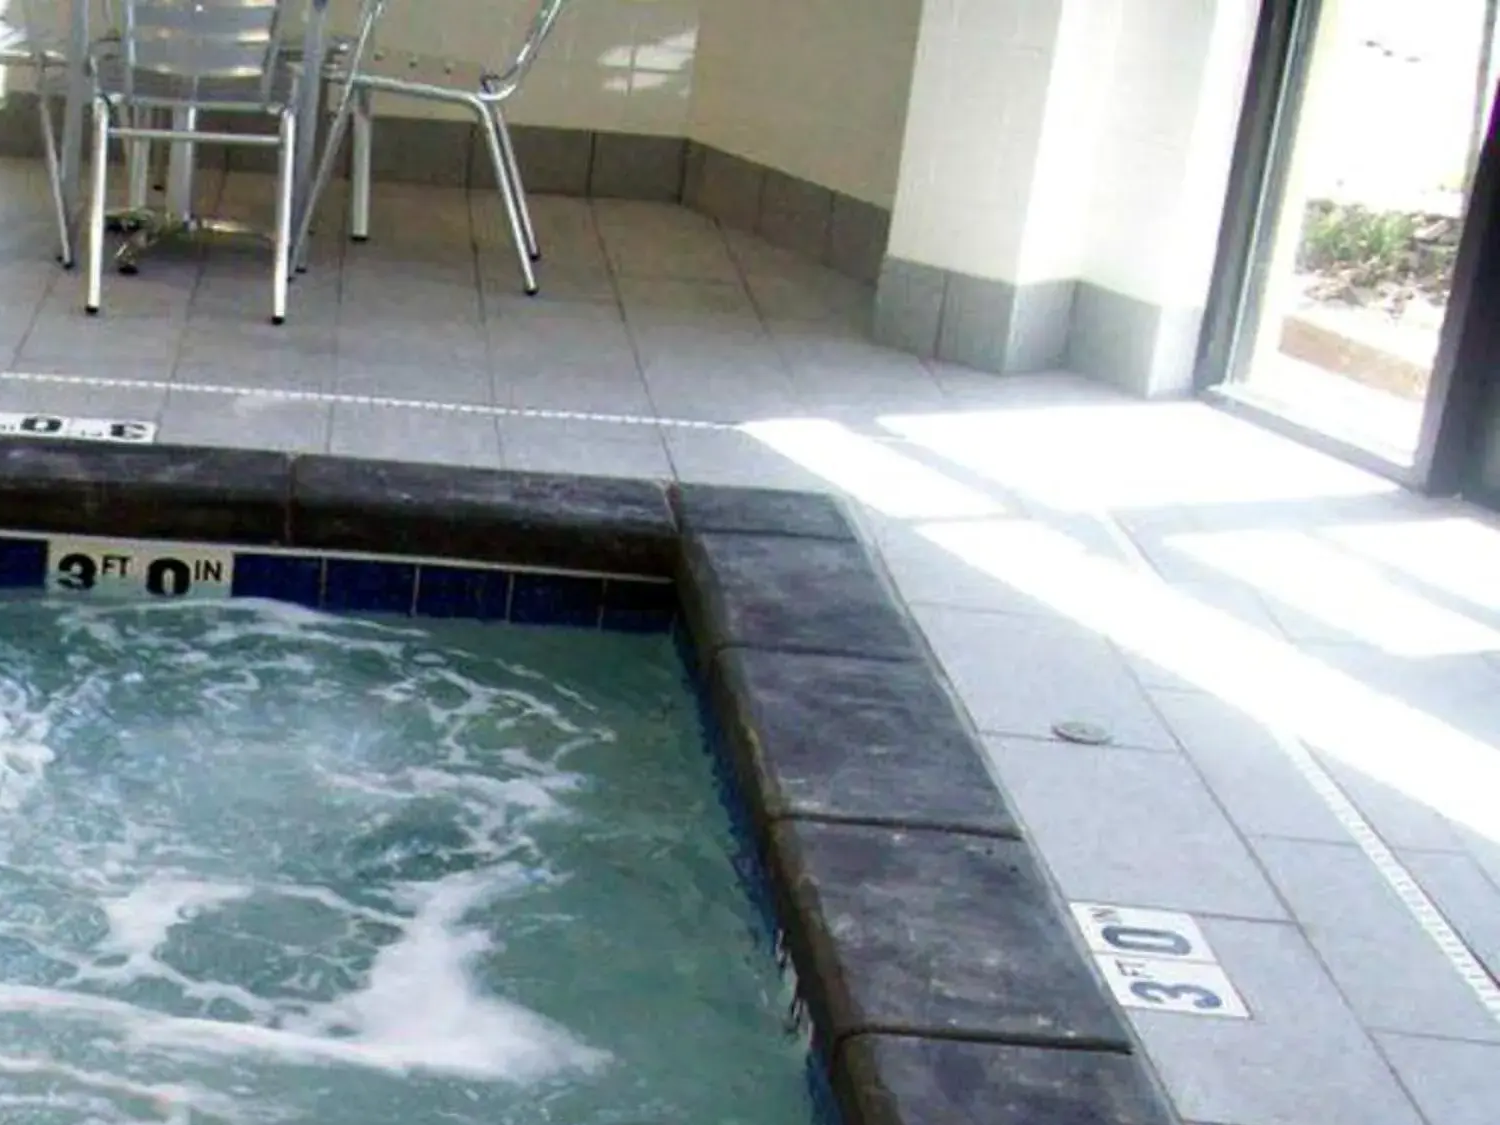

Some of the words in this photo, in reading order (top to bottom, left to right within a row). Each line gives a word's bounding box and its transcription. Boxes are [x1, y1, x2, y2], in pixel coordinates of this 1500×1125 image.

[57, 553, 97, 590] 3
[102, 555, 132, 577] FT
[146, 557, 190, 597] 0
[194, 559, 222, 581] IN
[1101, 926, 1192, 956] 0
[1129, 981, 1223, 1008] 3
